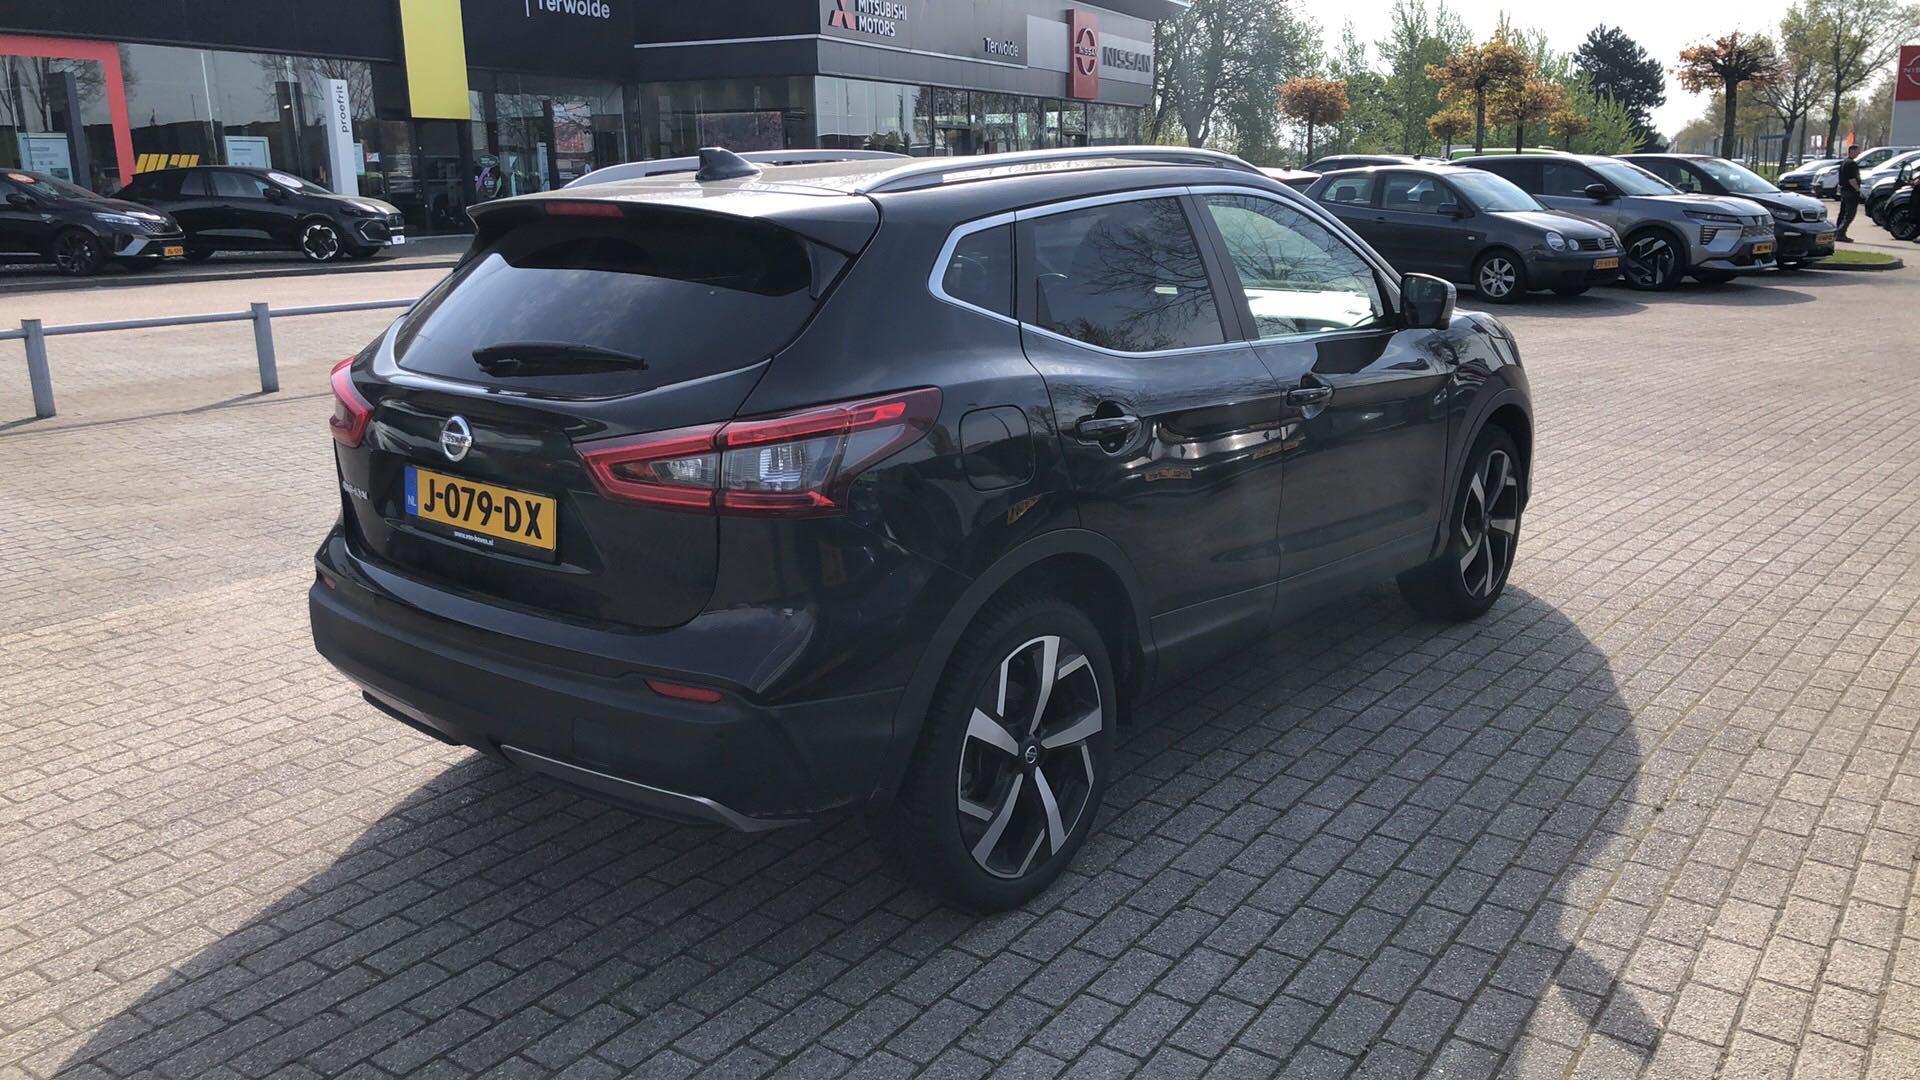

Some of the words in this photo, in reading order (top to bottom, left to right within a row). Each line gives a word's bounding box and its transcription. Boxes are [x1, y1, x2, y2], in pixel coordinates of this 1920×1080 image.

[859, 0, 907, 20] MITSUBISHI
[859, 15, 896, 37] MOTORS
[985, 37, 1019, 57] Terwolde
[1102, 46, 1151, 73] NISSAN
[336, 85, 349, 133] proefrit
[407, 494, 417, 507] NL
[424, 478, 542, 540] J-079-DX
